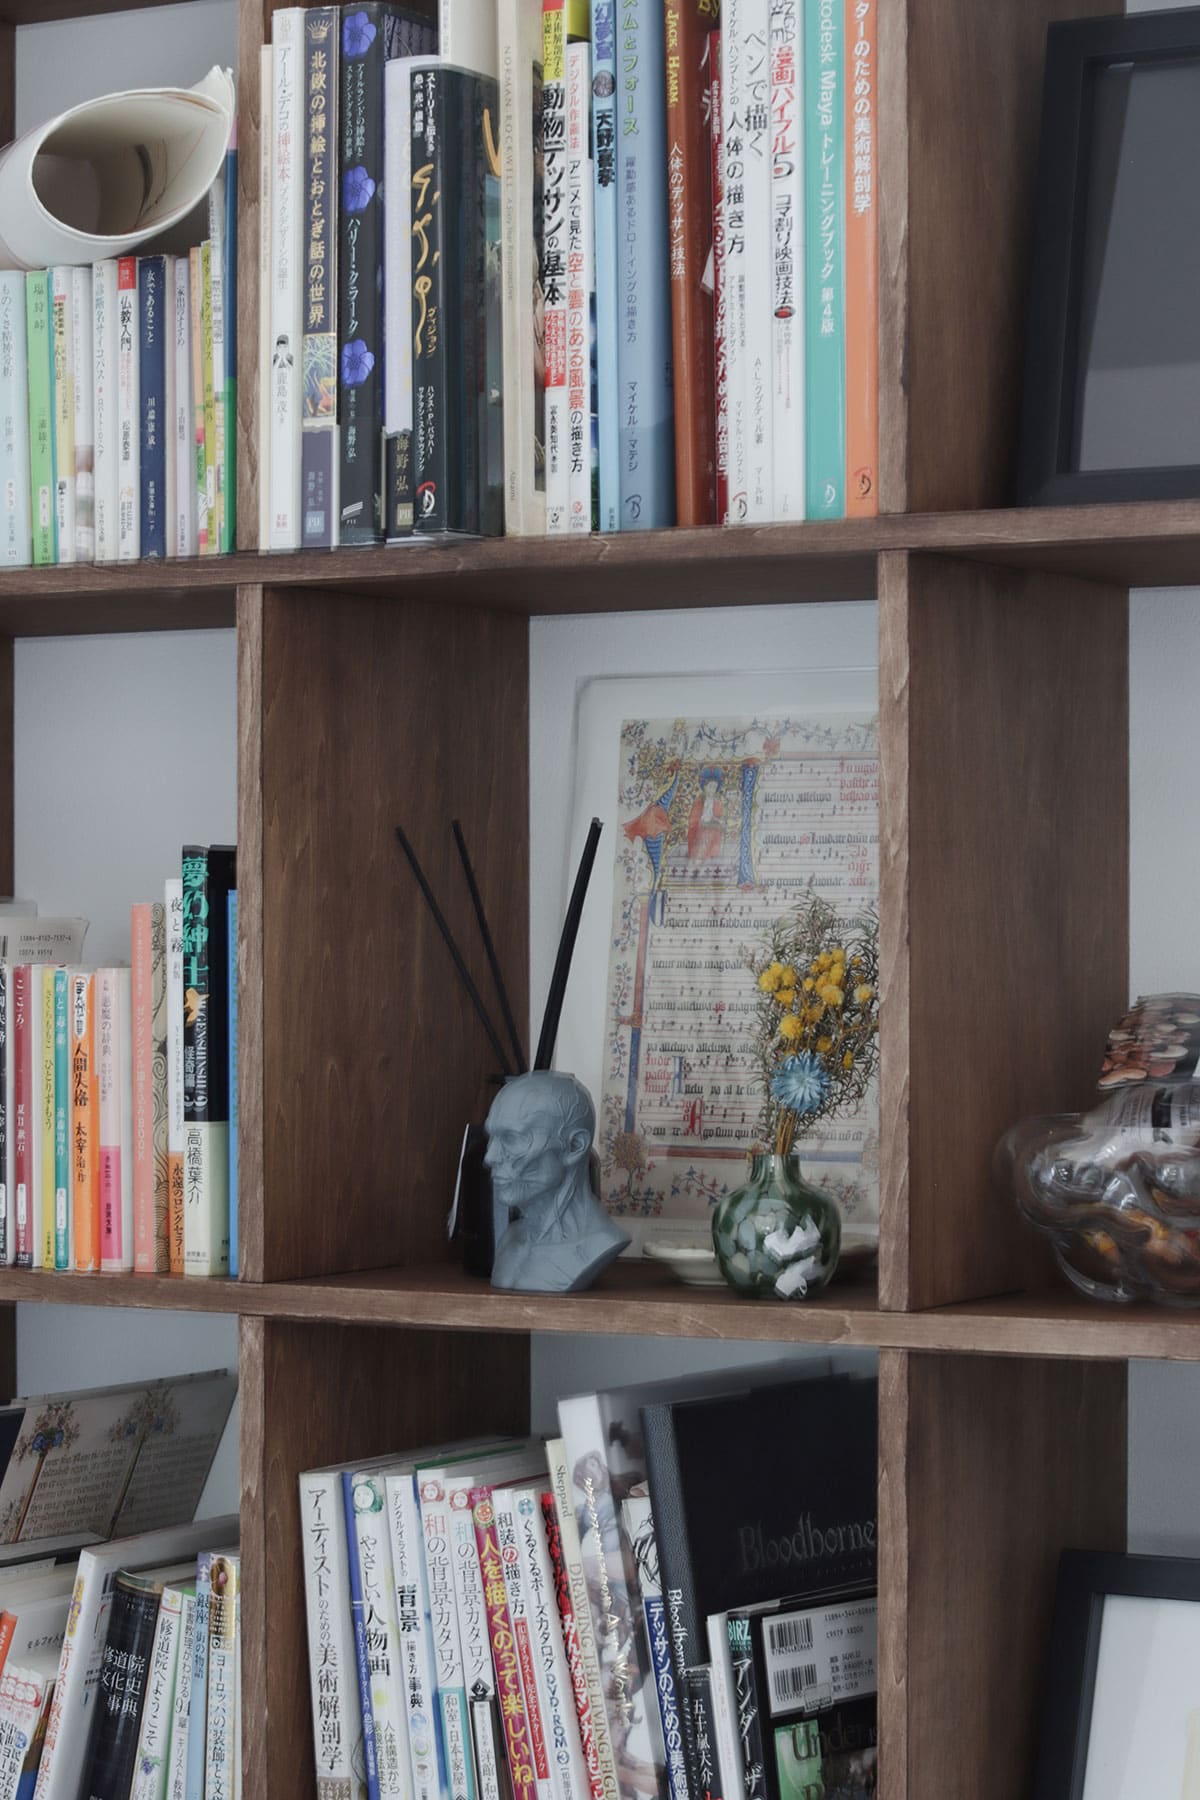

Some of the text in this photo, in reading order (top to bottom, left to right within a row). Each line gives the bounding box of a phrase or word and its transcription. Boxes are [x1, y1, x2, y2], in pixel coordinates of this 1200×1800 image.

[553, 10, 563, 77] 美術解剖学を
[666, 9, 680, 50] JACK
[345, 64, 354, 160] ステンドグラスの世界
[356, 63, 366, 159] アイルランドの挿絵と
[414, 73, 424, 134] 色、光、構図
[427, 72, 437, 153] ストーリーを伝える
[504, 46, 513, 188] NORMAN ROCKWELL
[744, 29, 769, 157] ペンで描く
[770, 45, 796, 179] 漫画バイブル5
[817, 70, 836, 125] Maya
[853, 0, 871, 216] ターのための美術解剖学
[310, 50, 328, 330] 北欧の挿絵とおとぎ話の世界
[596, 108, 616, 189] 天野喜孝
[726, 111, 745, 255] 人体の描き方
[543, 85, 566, 306] 動物デッサンの基本
[669, 141, 687, 279] 人体のデッサン技法
[820, 133, 836, 281] トレーニングブック
[348, 218, 361, 338] ハリー・クラーク
[625, 156, 638, 344] 躍動感あるドローイングの描き方
[774, 193, 793, 306] コマ割り映画技法
[119, 295, 132, 353] 仏教入門
[145, 269, 157, 345] 女であること
[176, 285, 186, 347] 家出のすすめ
[427, 307, 438, 354] ヴィジョン
[567, 159, 586, 474] アニメで見た空と雲のある風景の描き方
[820, 287, 836, 336] 第4版
[146, 397, 157, 448] 川端康成
[396, 434, 409, 493] 海野弘
[427, 385, 436, 455] ハンス・P・バッハー
[627, 381, 639, 473] マイケル・マテジ
[183, 857, 209, 987] 夢幻紳士
[17, 978, 25, 1026] こころ
[73, 1042, 89, 1107] 人間失格
[172, 1163, 185, 1257] 永遠のロングセラー
[186, 1128, 203, 1205] 高橋葉介
[554, 1464, 574, 1519] Sheppard
[497, 1511, 525, 1616] 和装の描き方
[738, 1511, 877, 1574] Bloodborne
[308, 1487, 344, 1771] アーティストのための美術解剖学
[360, 1534, 392, 1678] やさしい人物画
[424, 1513, 462, 1684] 和の背景カタログ
[455, 1520, 491, 1678] 和の背景カタログ
[523, 1519, 556, 1673] ぐるぐるポーズカタログ
[569, 1562, 594, 1649] DRAWING
[667, 1585, 686, 1681] Bloodborne
[727, 1618, 752, 1644] BIRZ
[102, 1667, 142, 1696] 文化史
[103, 1643, 146, 1675] 修道院
[146, 1617, 174, 1747] 修道院へようこそ
[587, 1655, 600, 1694] THE
[108, 1692, 137, 1719] 事典
[590, 1694, 609, 1755] LIVING
[693, 1698, 714, 1789] 五十嵐大介
[732, 1657, 763, 1800] アンダーザ
[384, 1719, 401, 1796] 人体構造から
